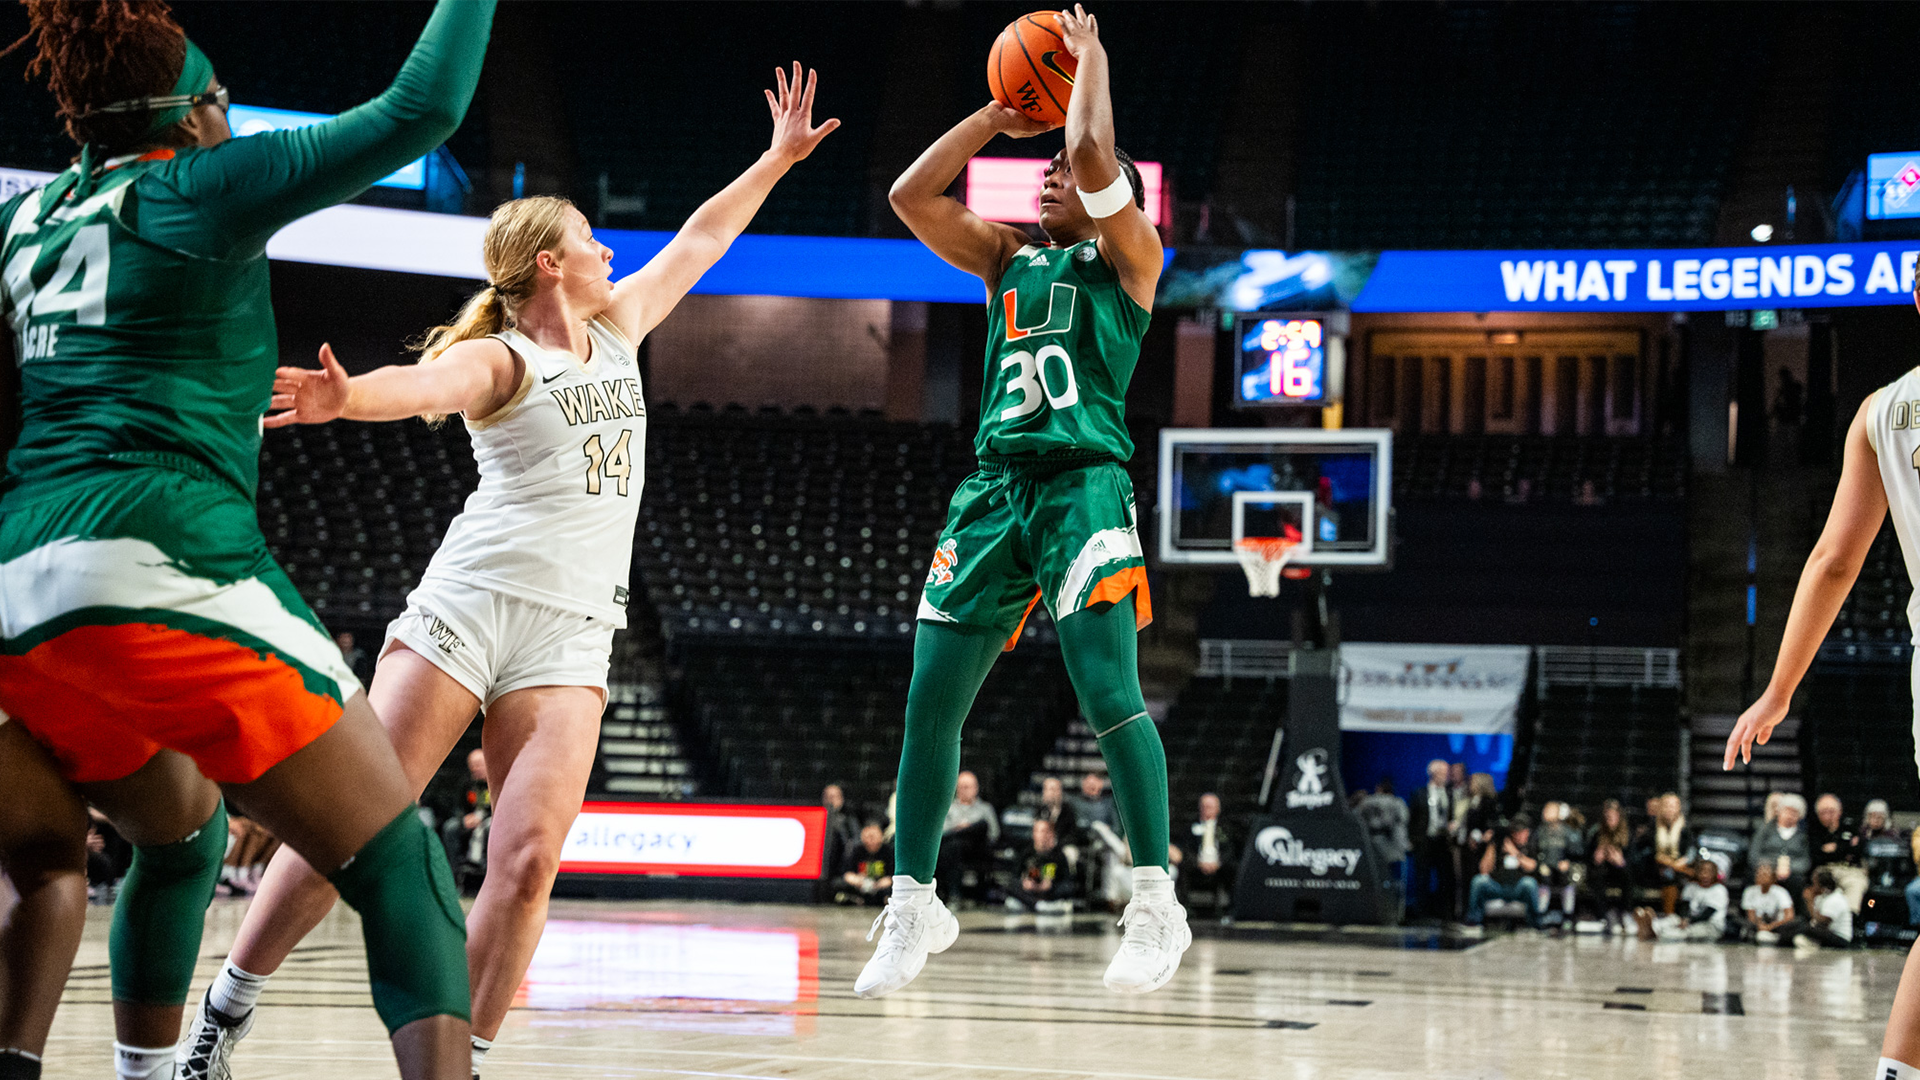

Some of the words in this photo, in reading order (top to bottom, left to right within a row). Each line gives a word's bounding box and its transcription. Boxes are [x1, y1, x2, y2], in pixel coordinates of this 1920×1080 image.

[1017, 80, 1043, 113] WF
[1501, 260, 1637, 302] WHAT
[1646, 254, 1855, 301] LEGENDS
[1003, 282, 1077, 342] U
[1000, 345, 1079, 422] 30
[1270, 348, 1312, 397] 16
[550, 378, 645, 426] WAKE
[583, 429, 632, 497] 14
[575, 828, 698, 852] allegacy
[1266, 837, 1362, 876] Allegacy
